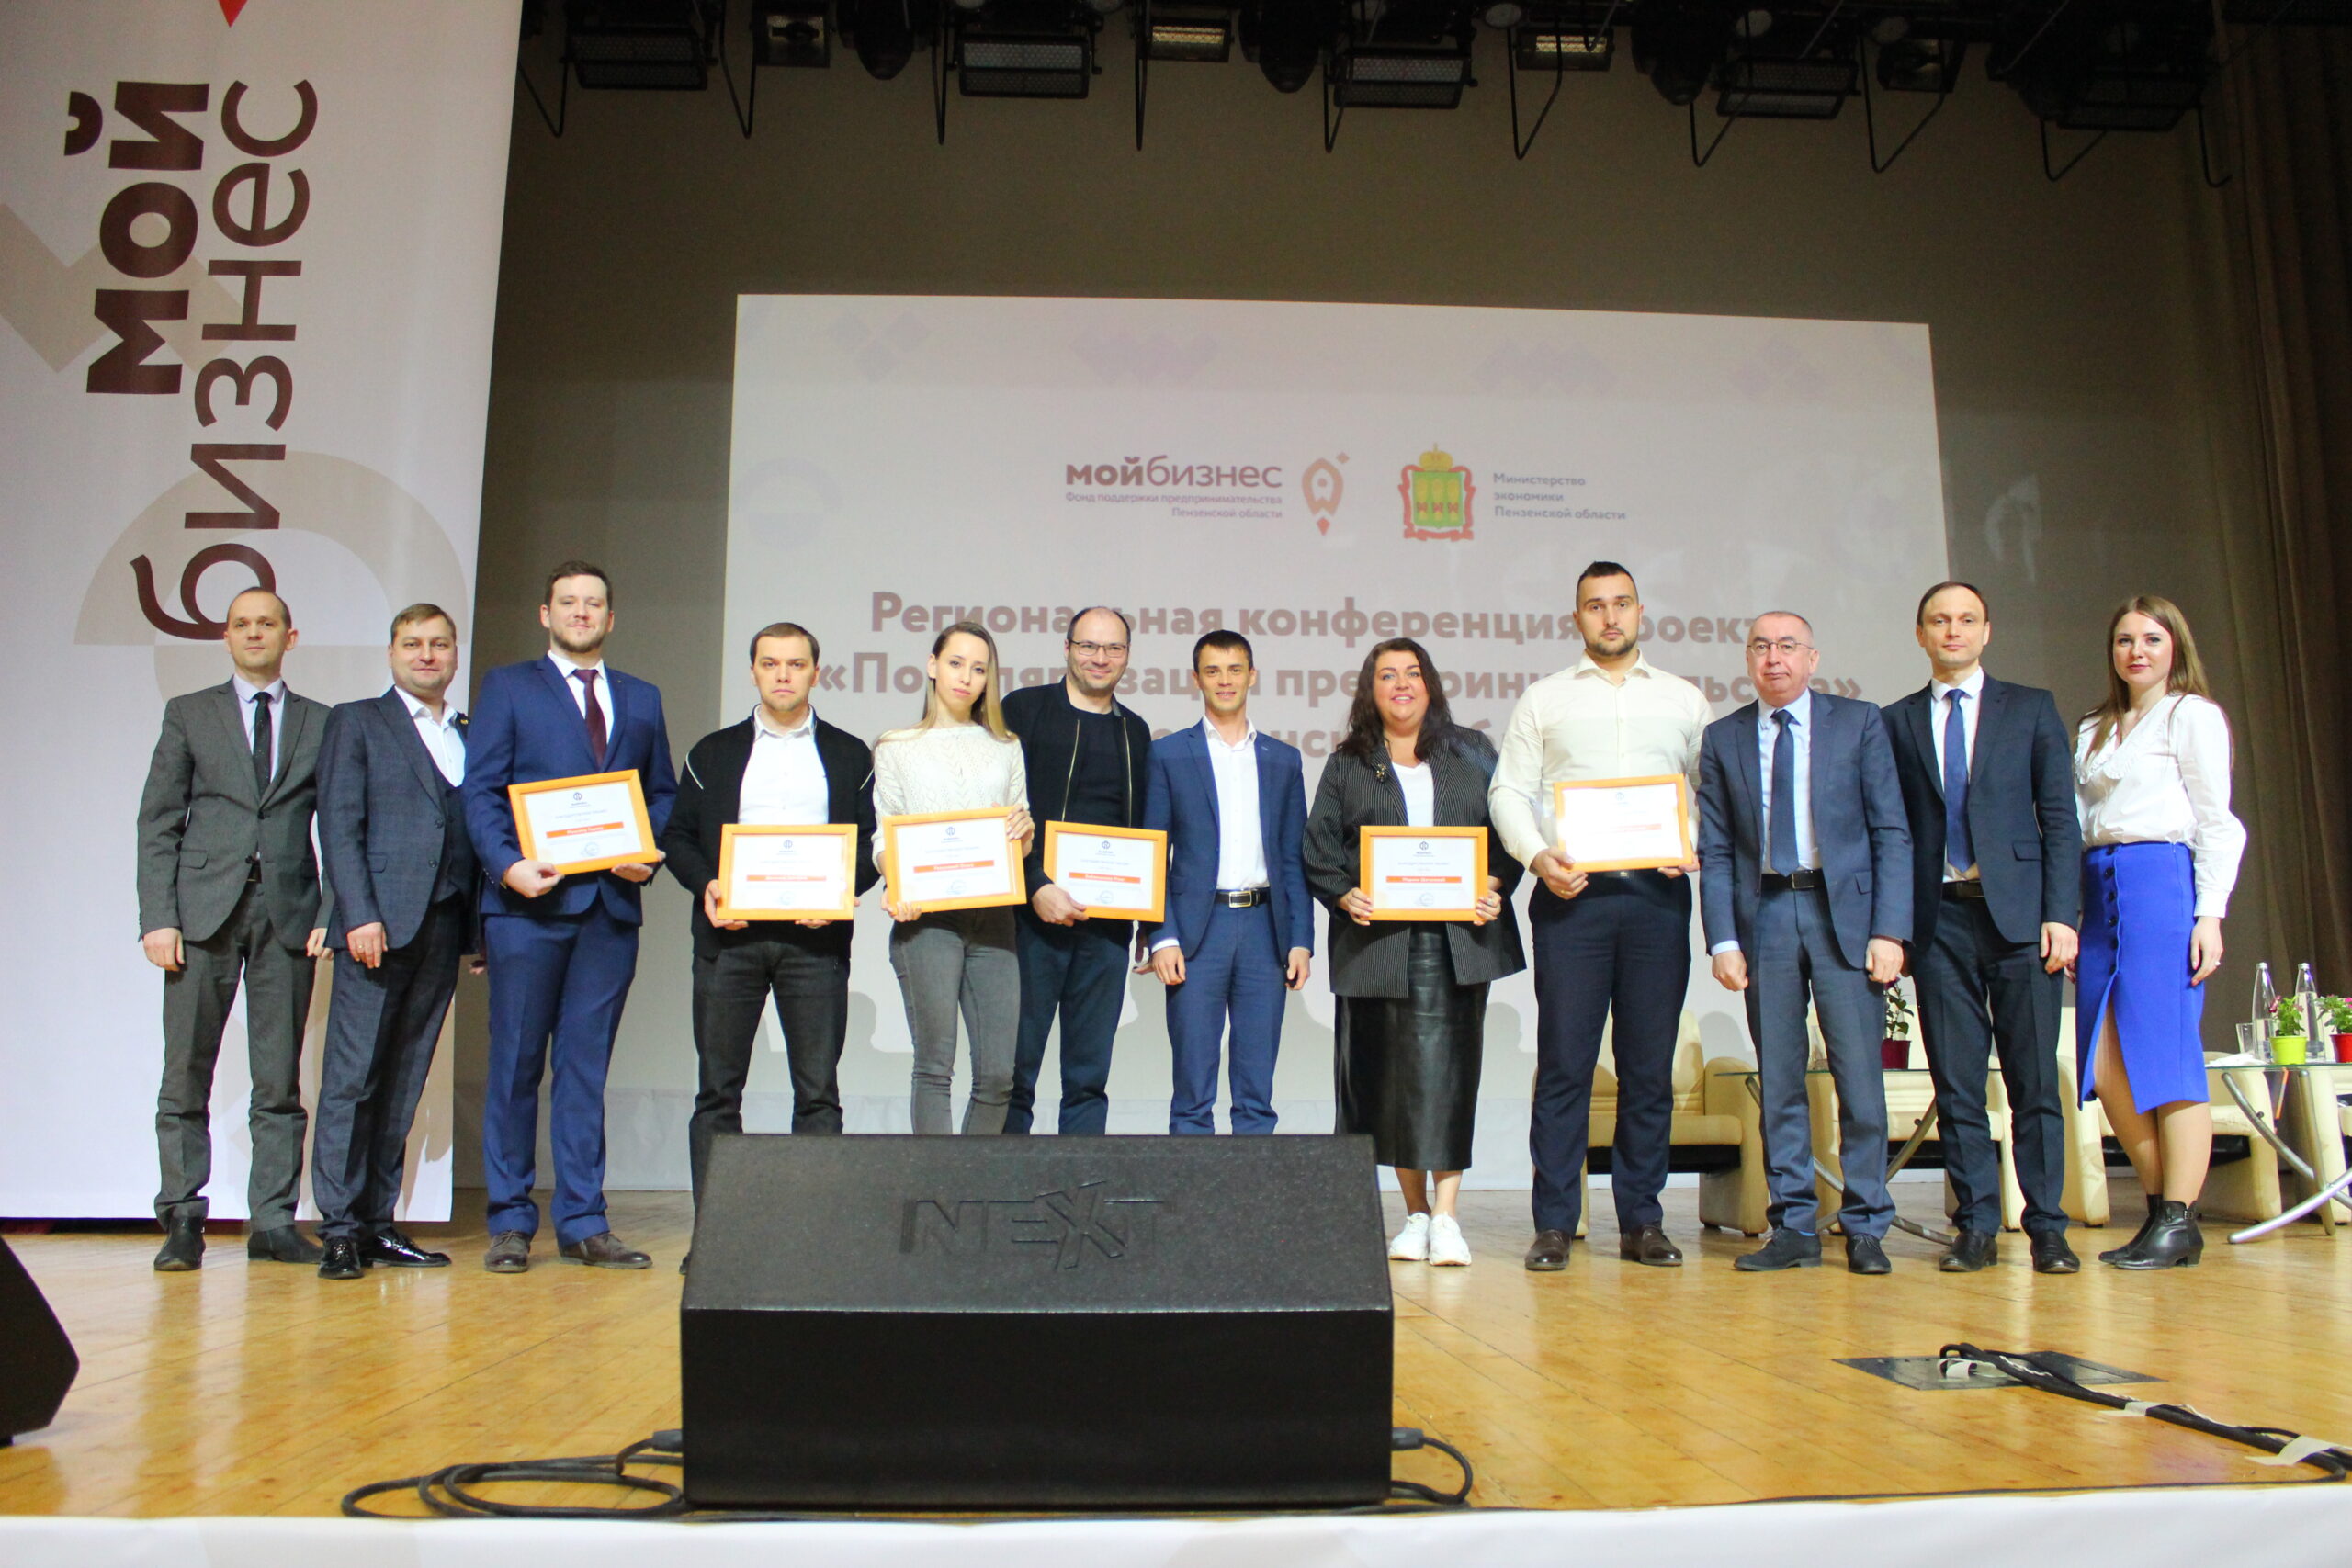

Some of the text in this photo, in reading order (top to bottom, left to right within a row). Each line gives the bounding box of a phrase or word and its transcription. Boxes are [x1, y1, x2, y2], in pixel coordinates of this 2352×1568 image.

[64, 80, 210, 395] мой
[130, 78, 318, 641] бизнес
[1493, 472, 1587, 487] Министерство
[1065, 492, 1283, 505] Фонд поддержки предпринимательства
[1493, 491, 1565, 502] экономики
[1171, 507, 1283, 519] Пензенской области
[1494, 505, 1627, 521] Пензенской области
[1238, 597, 1582, 648] конференция
[899, 1180, 1177, 1271] NEXT
